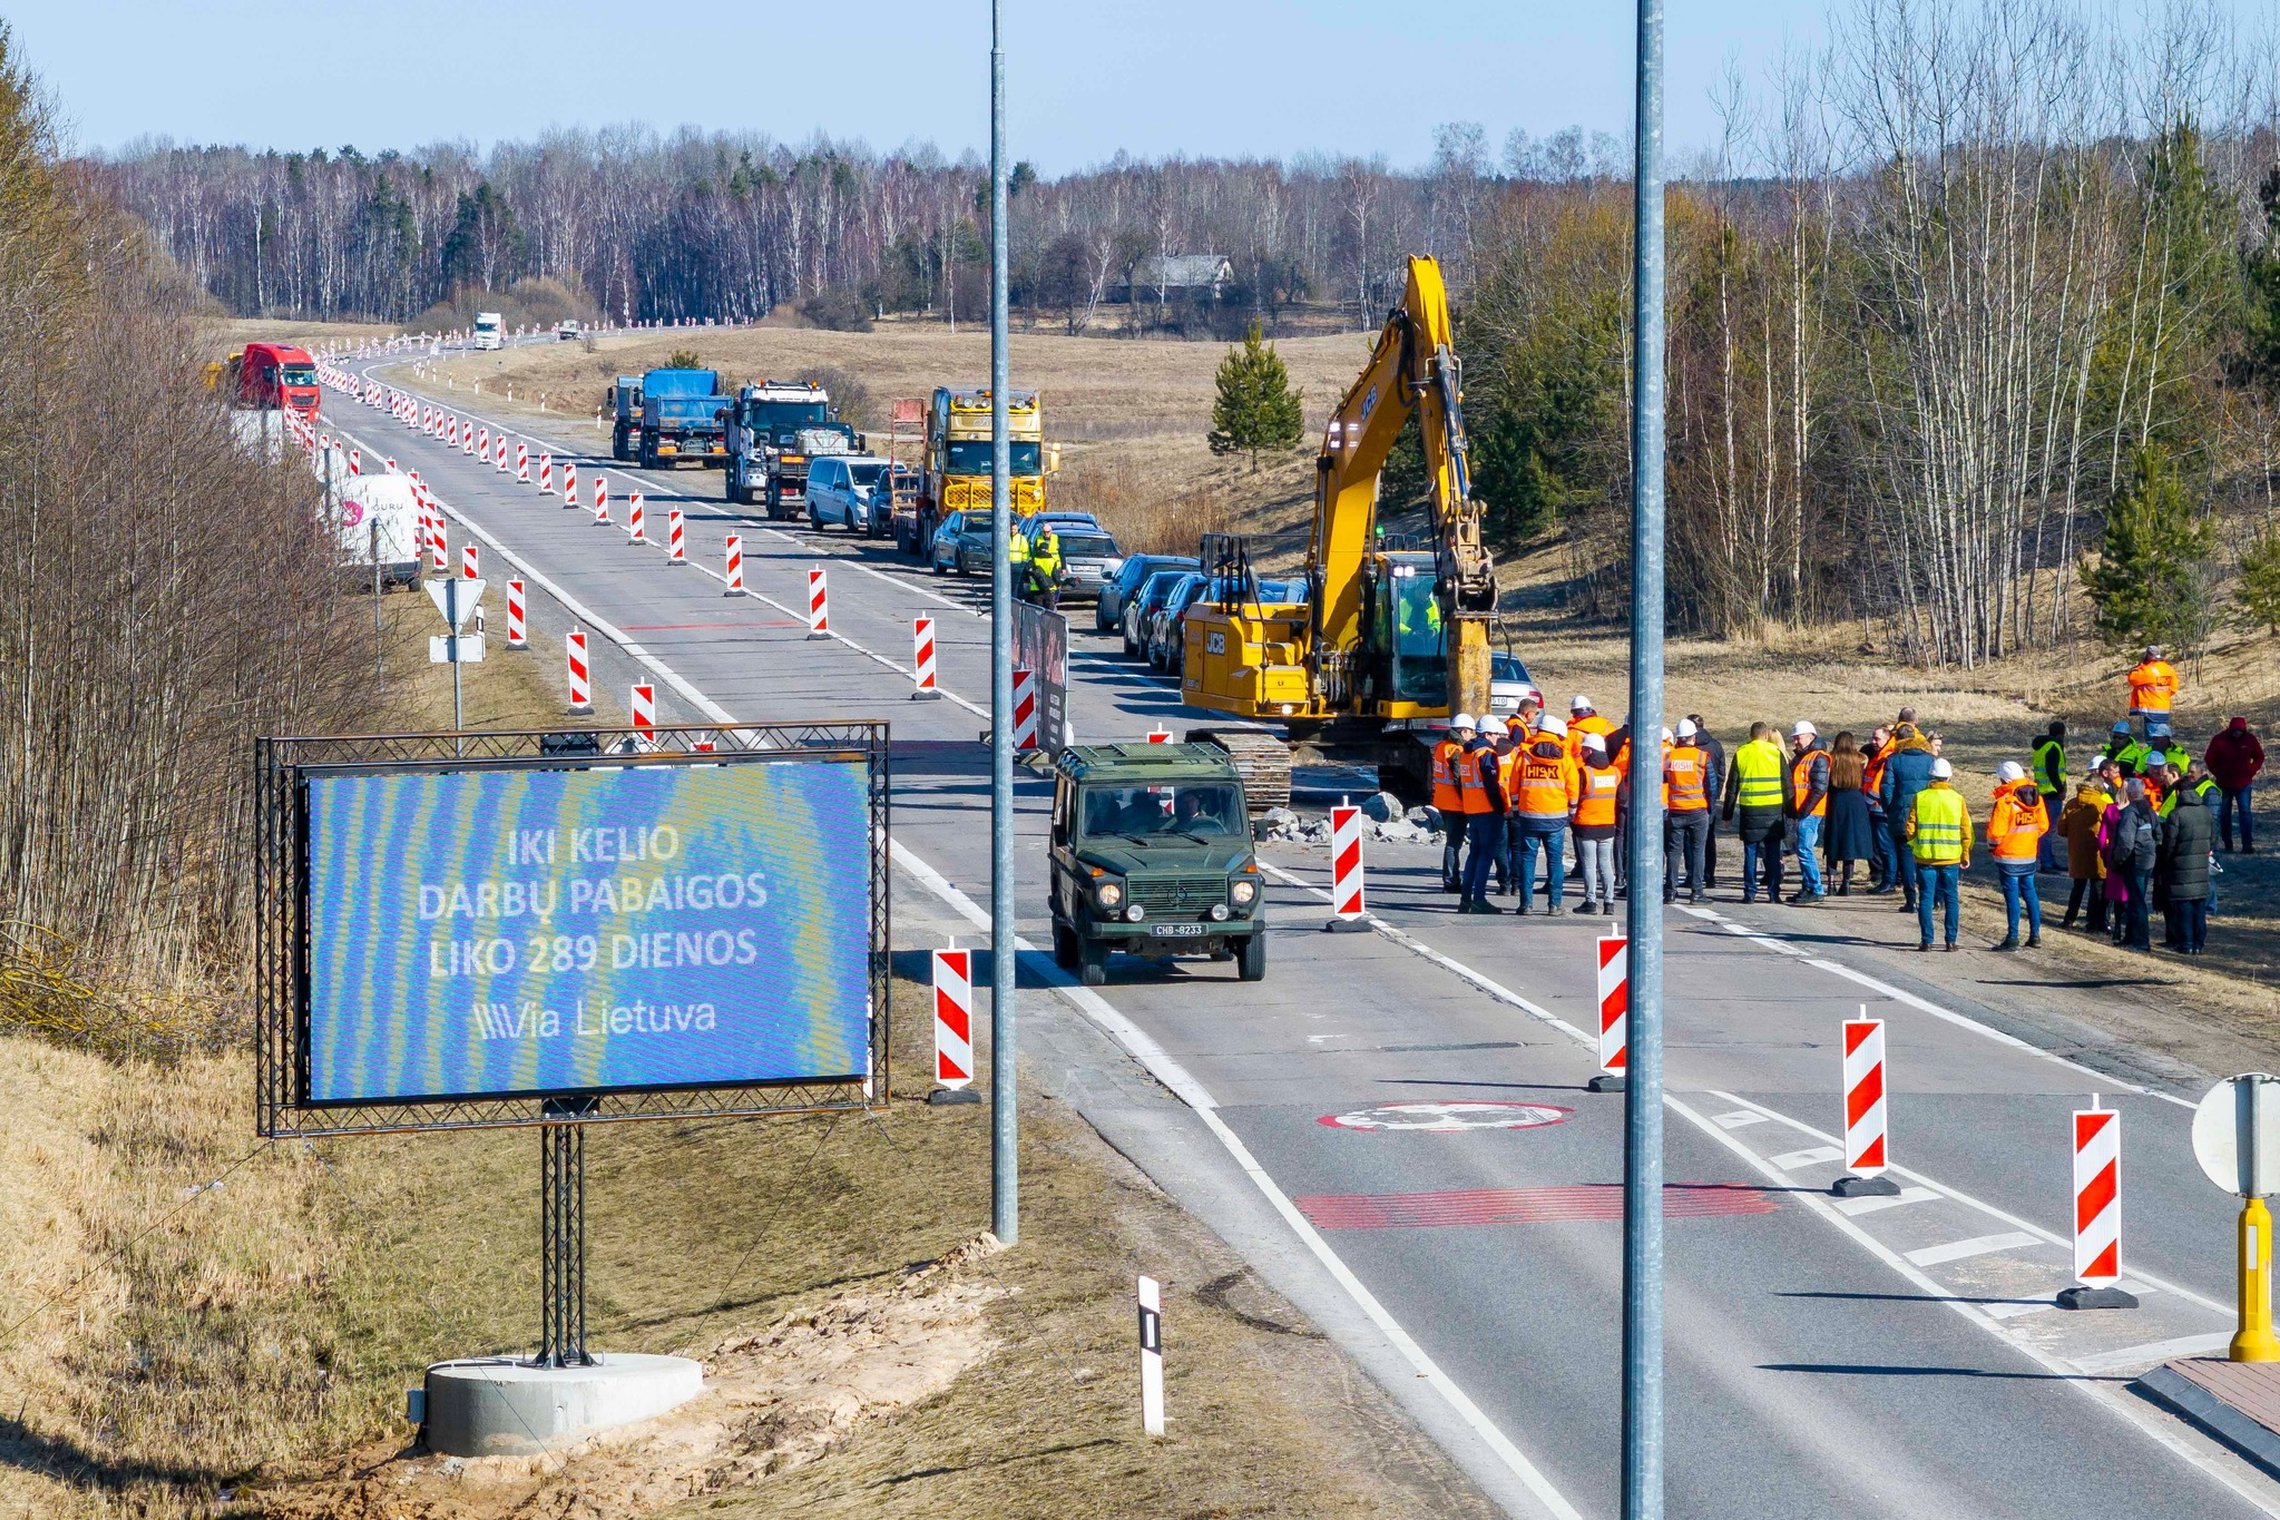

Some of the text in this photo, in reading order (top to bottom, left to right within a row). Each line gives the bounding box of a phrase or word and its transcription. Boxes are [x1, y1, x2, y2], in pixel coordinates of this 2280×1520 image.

[1361, 384, 1377, 421] JCB
[1206, 632, 1225, 653] JCB
[1527, 766, 1558, 778] HISK
[509, 825, 679, 864] IKI KELIO
[419, 872, 767, 925] DARBŲ PABAIGOS
[431, 929, 757, 977] LIKO 289 DIENOS
[577, 999, 716, 1036] Lietuva
